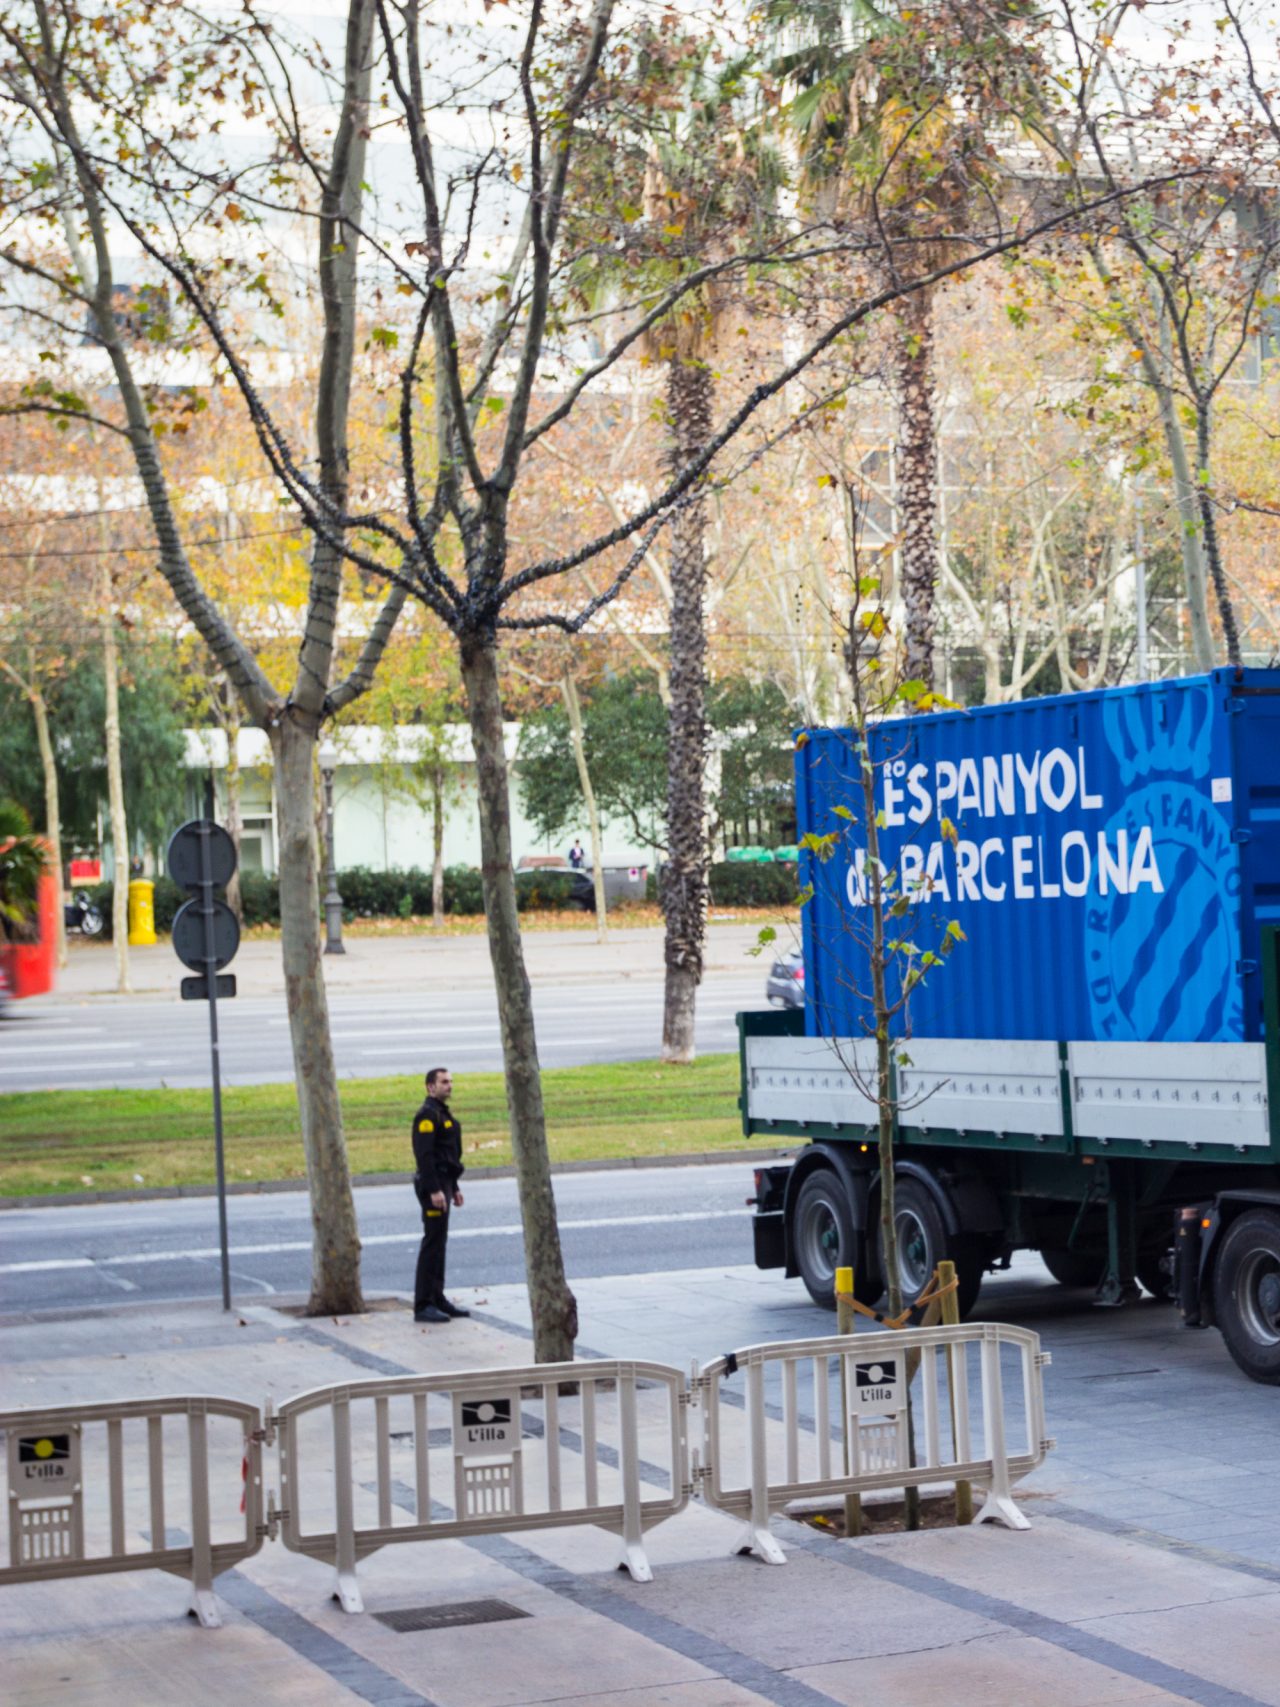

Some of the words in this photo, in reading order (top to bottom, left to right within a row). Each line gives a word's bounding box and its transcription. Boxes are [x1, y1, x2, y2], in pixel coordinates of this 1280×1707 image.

[884, 747, 1103, 826] ESPANYOL
[900, 826, 1165, 904] BARCELONA
[861, 1388, 892, 1402] L'illa
[468, 1427, 506, 1442] L'illa
[25, 1463, 64, 1479] L'illa
